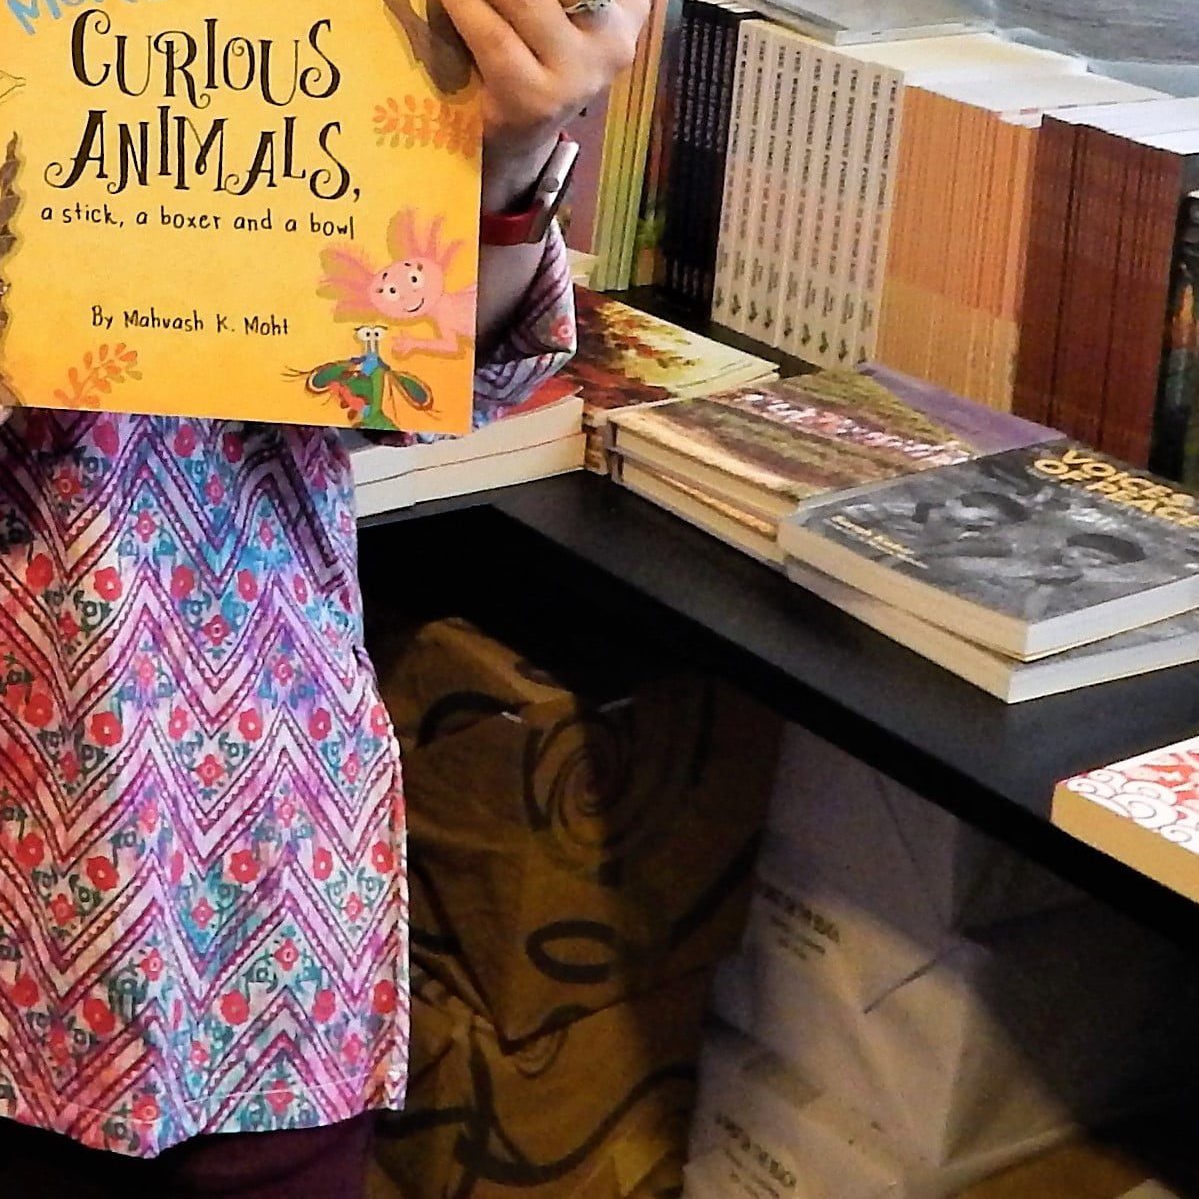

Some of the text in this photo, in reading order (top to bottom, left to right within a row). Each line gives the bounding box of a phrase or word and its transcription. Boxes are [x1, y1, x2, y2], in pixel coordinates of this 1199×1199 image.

[71, 8, 341, 109] CURIOUS
[44, 105, 361, 202] ANIMALS,
[41, 202, 354, 240] a stick, a boxer and a bowl
[92, 305, 113, 330] By
[124, 307, 204, 332] Mahvash
[216, 314, 235, 333] K.
[1034, 458, 1092, 482] OF
